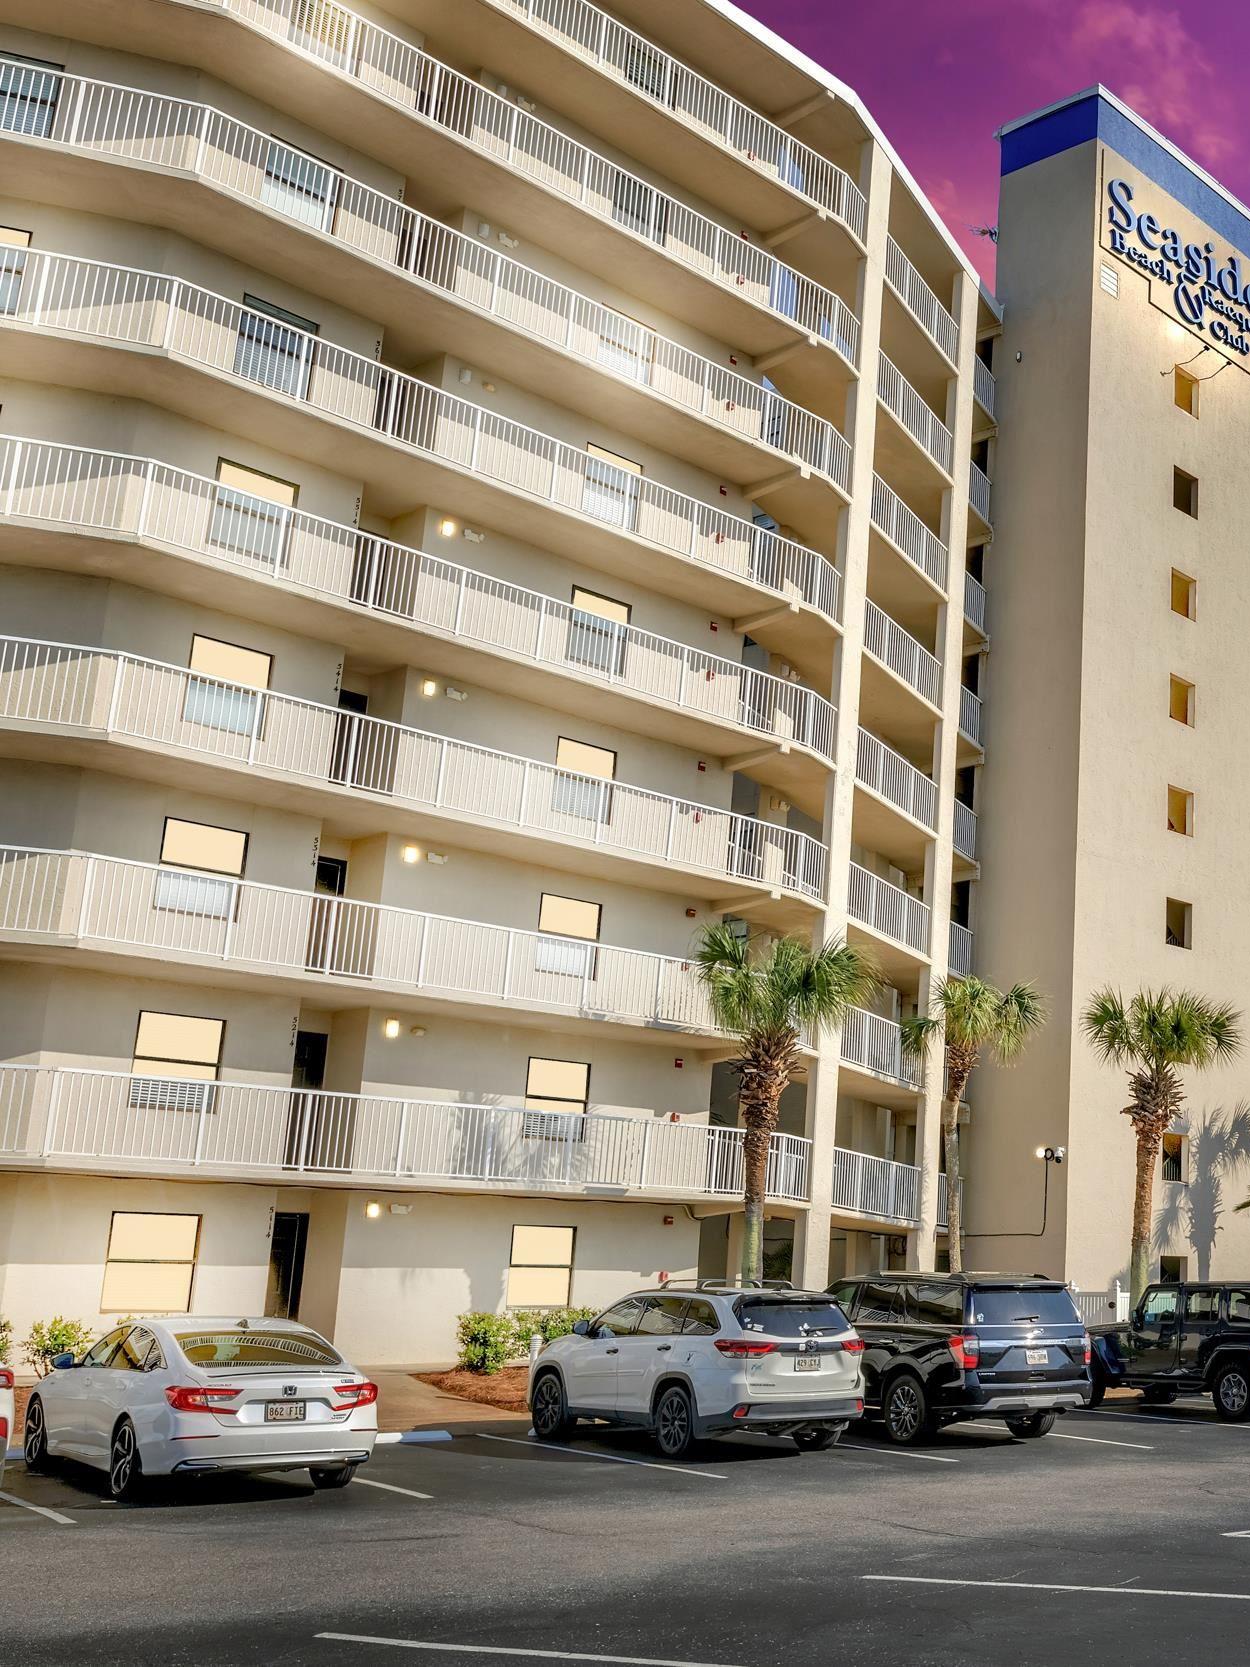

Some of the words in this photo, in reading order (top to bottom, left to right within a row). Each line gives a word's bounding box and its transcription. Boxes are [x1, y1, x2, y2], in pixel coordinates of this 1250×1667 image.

[1109, 228, 1174, 286] Beach
[1209, 320, 1250, 356] Club
[289, 1016, 298, 1047] 5214
[269, 1406, 284, 1417] 862
[288, 1406, 304, 1417] FIE
